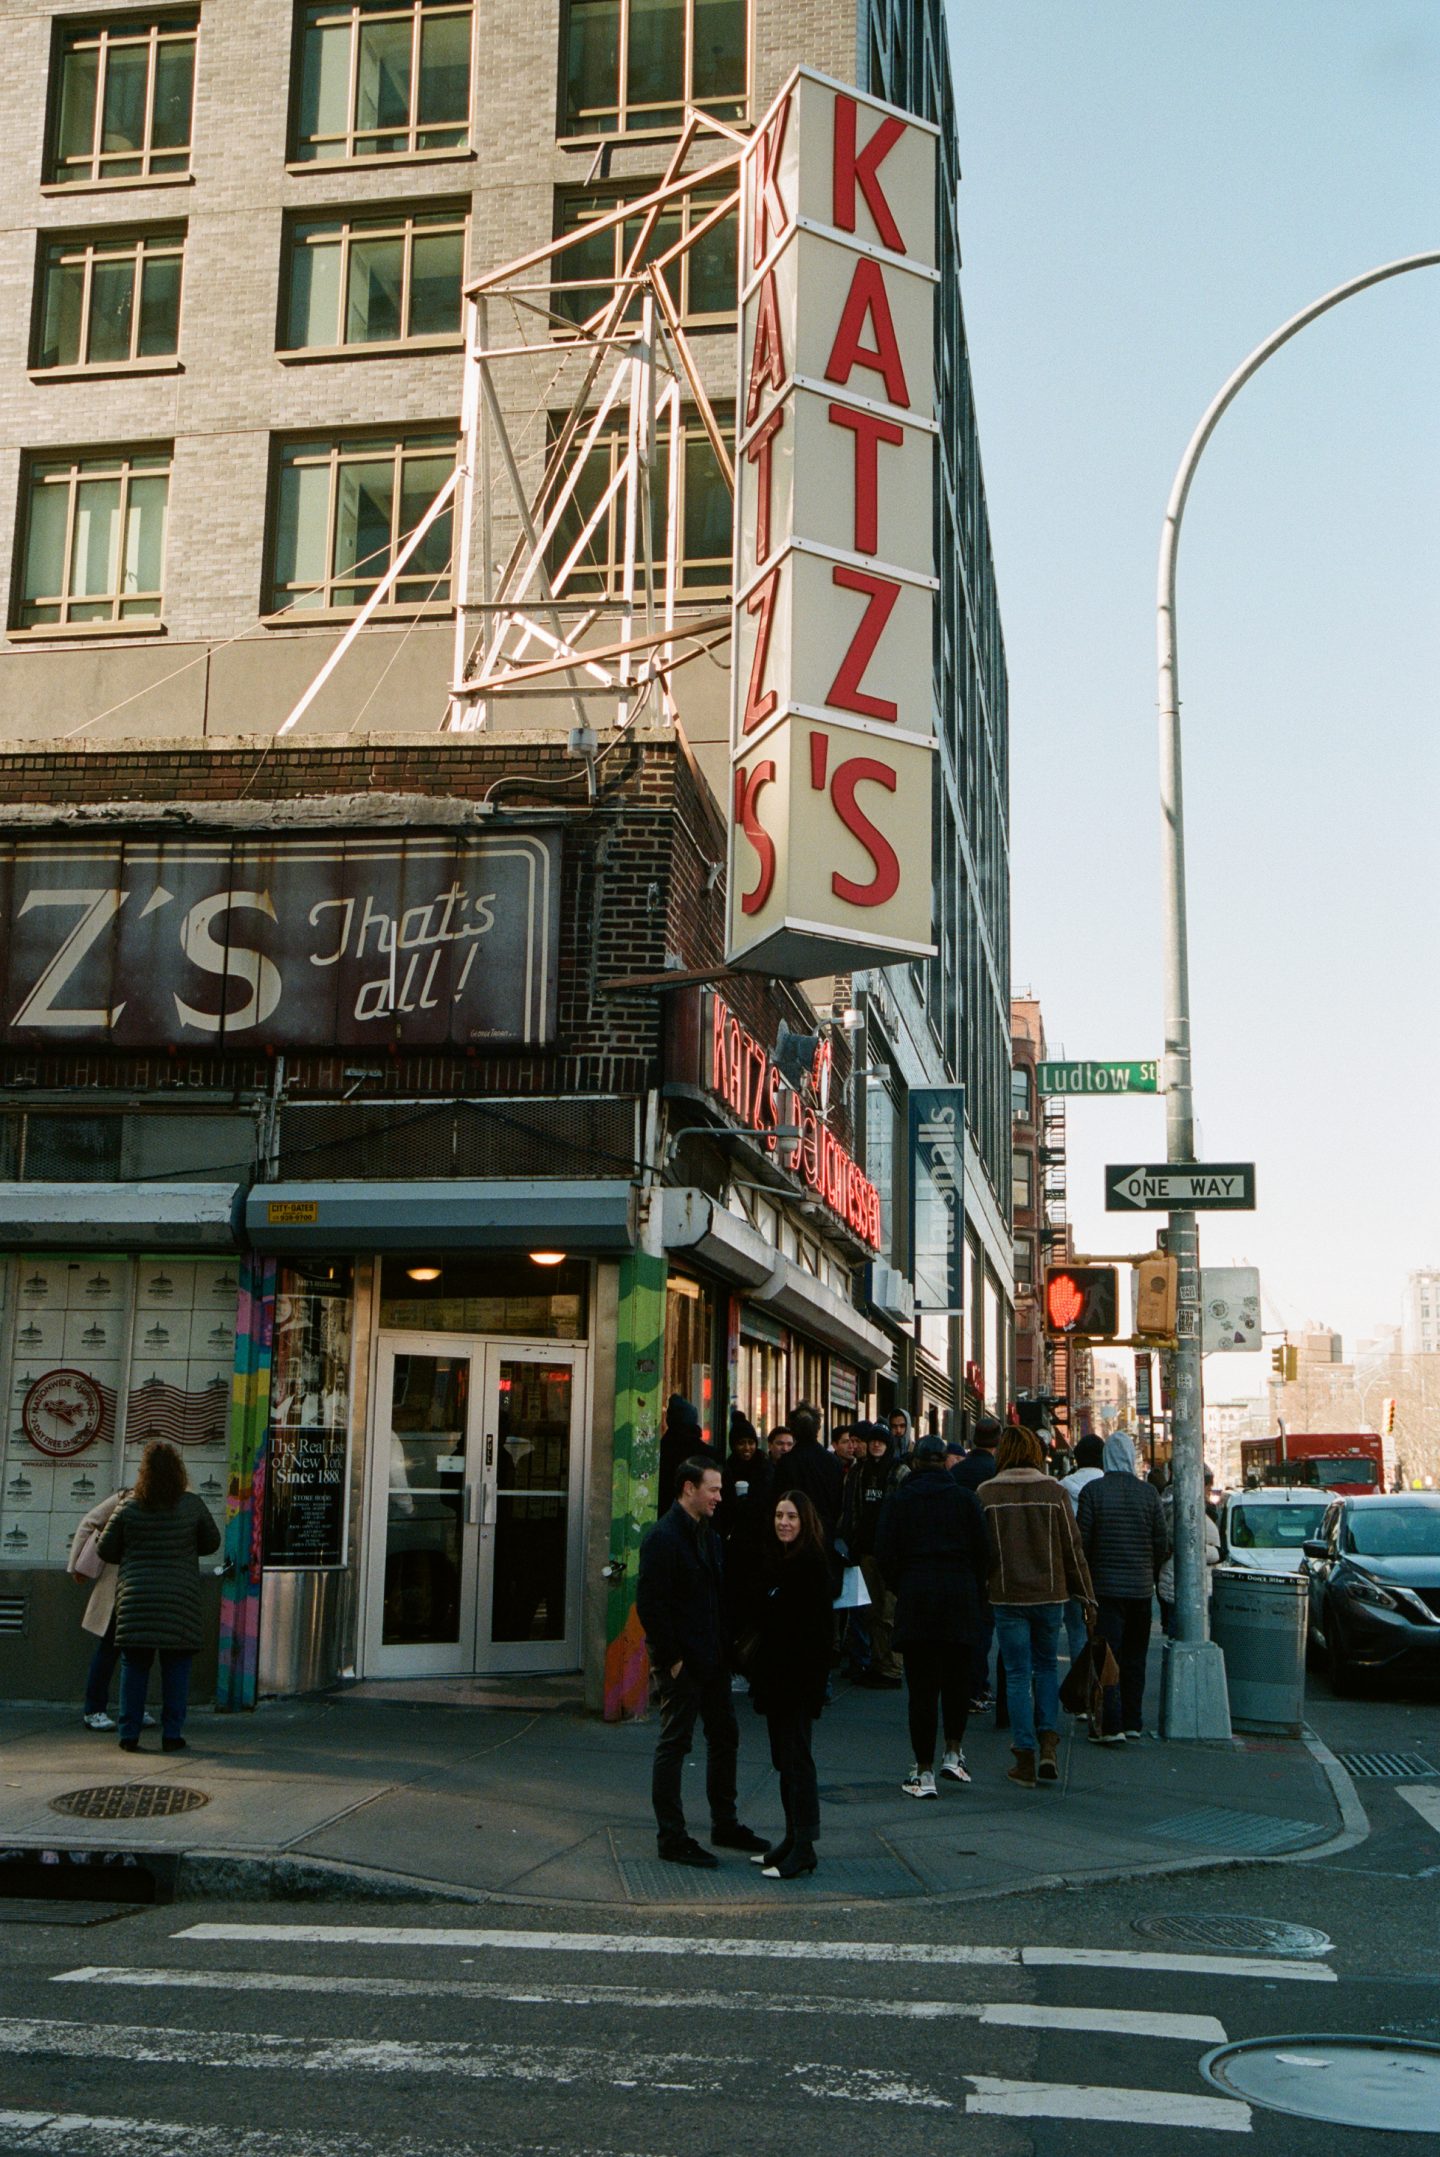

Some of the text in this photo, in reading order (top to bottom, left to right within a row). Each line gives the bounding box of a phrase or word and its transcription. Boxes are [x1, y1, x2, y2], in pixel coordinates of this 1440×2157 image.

[735, 94, 792, 915] KATZ'S
[808, 93, 911, 907] KATZ'S
[10, 881, 496, 1032] Z'S That's
[1042, 1064, 1155, 1091] Ludlow St
[917, 1105, 956, 1292] Marshalls
[1128, 1177, 1235, 1197] ONE WAY
[269, 1438, 296, 1454] The
[299, 1438, 326, 1454] Real
[271, 1453, 290, 1470] of
[291, 1454, 321, 1469] New
[276, 1468, 315, 1484] Since
